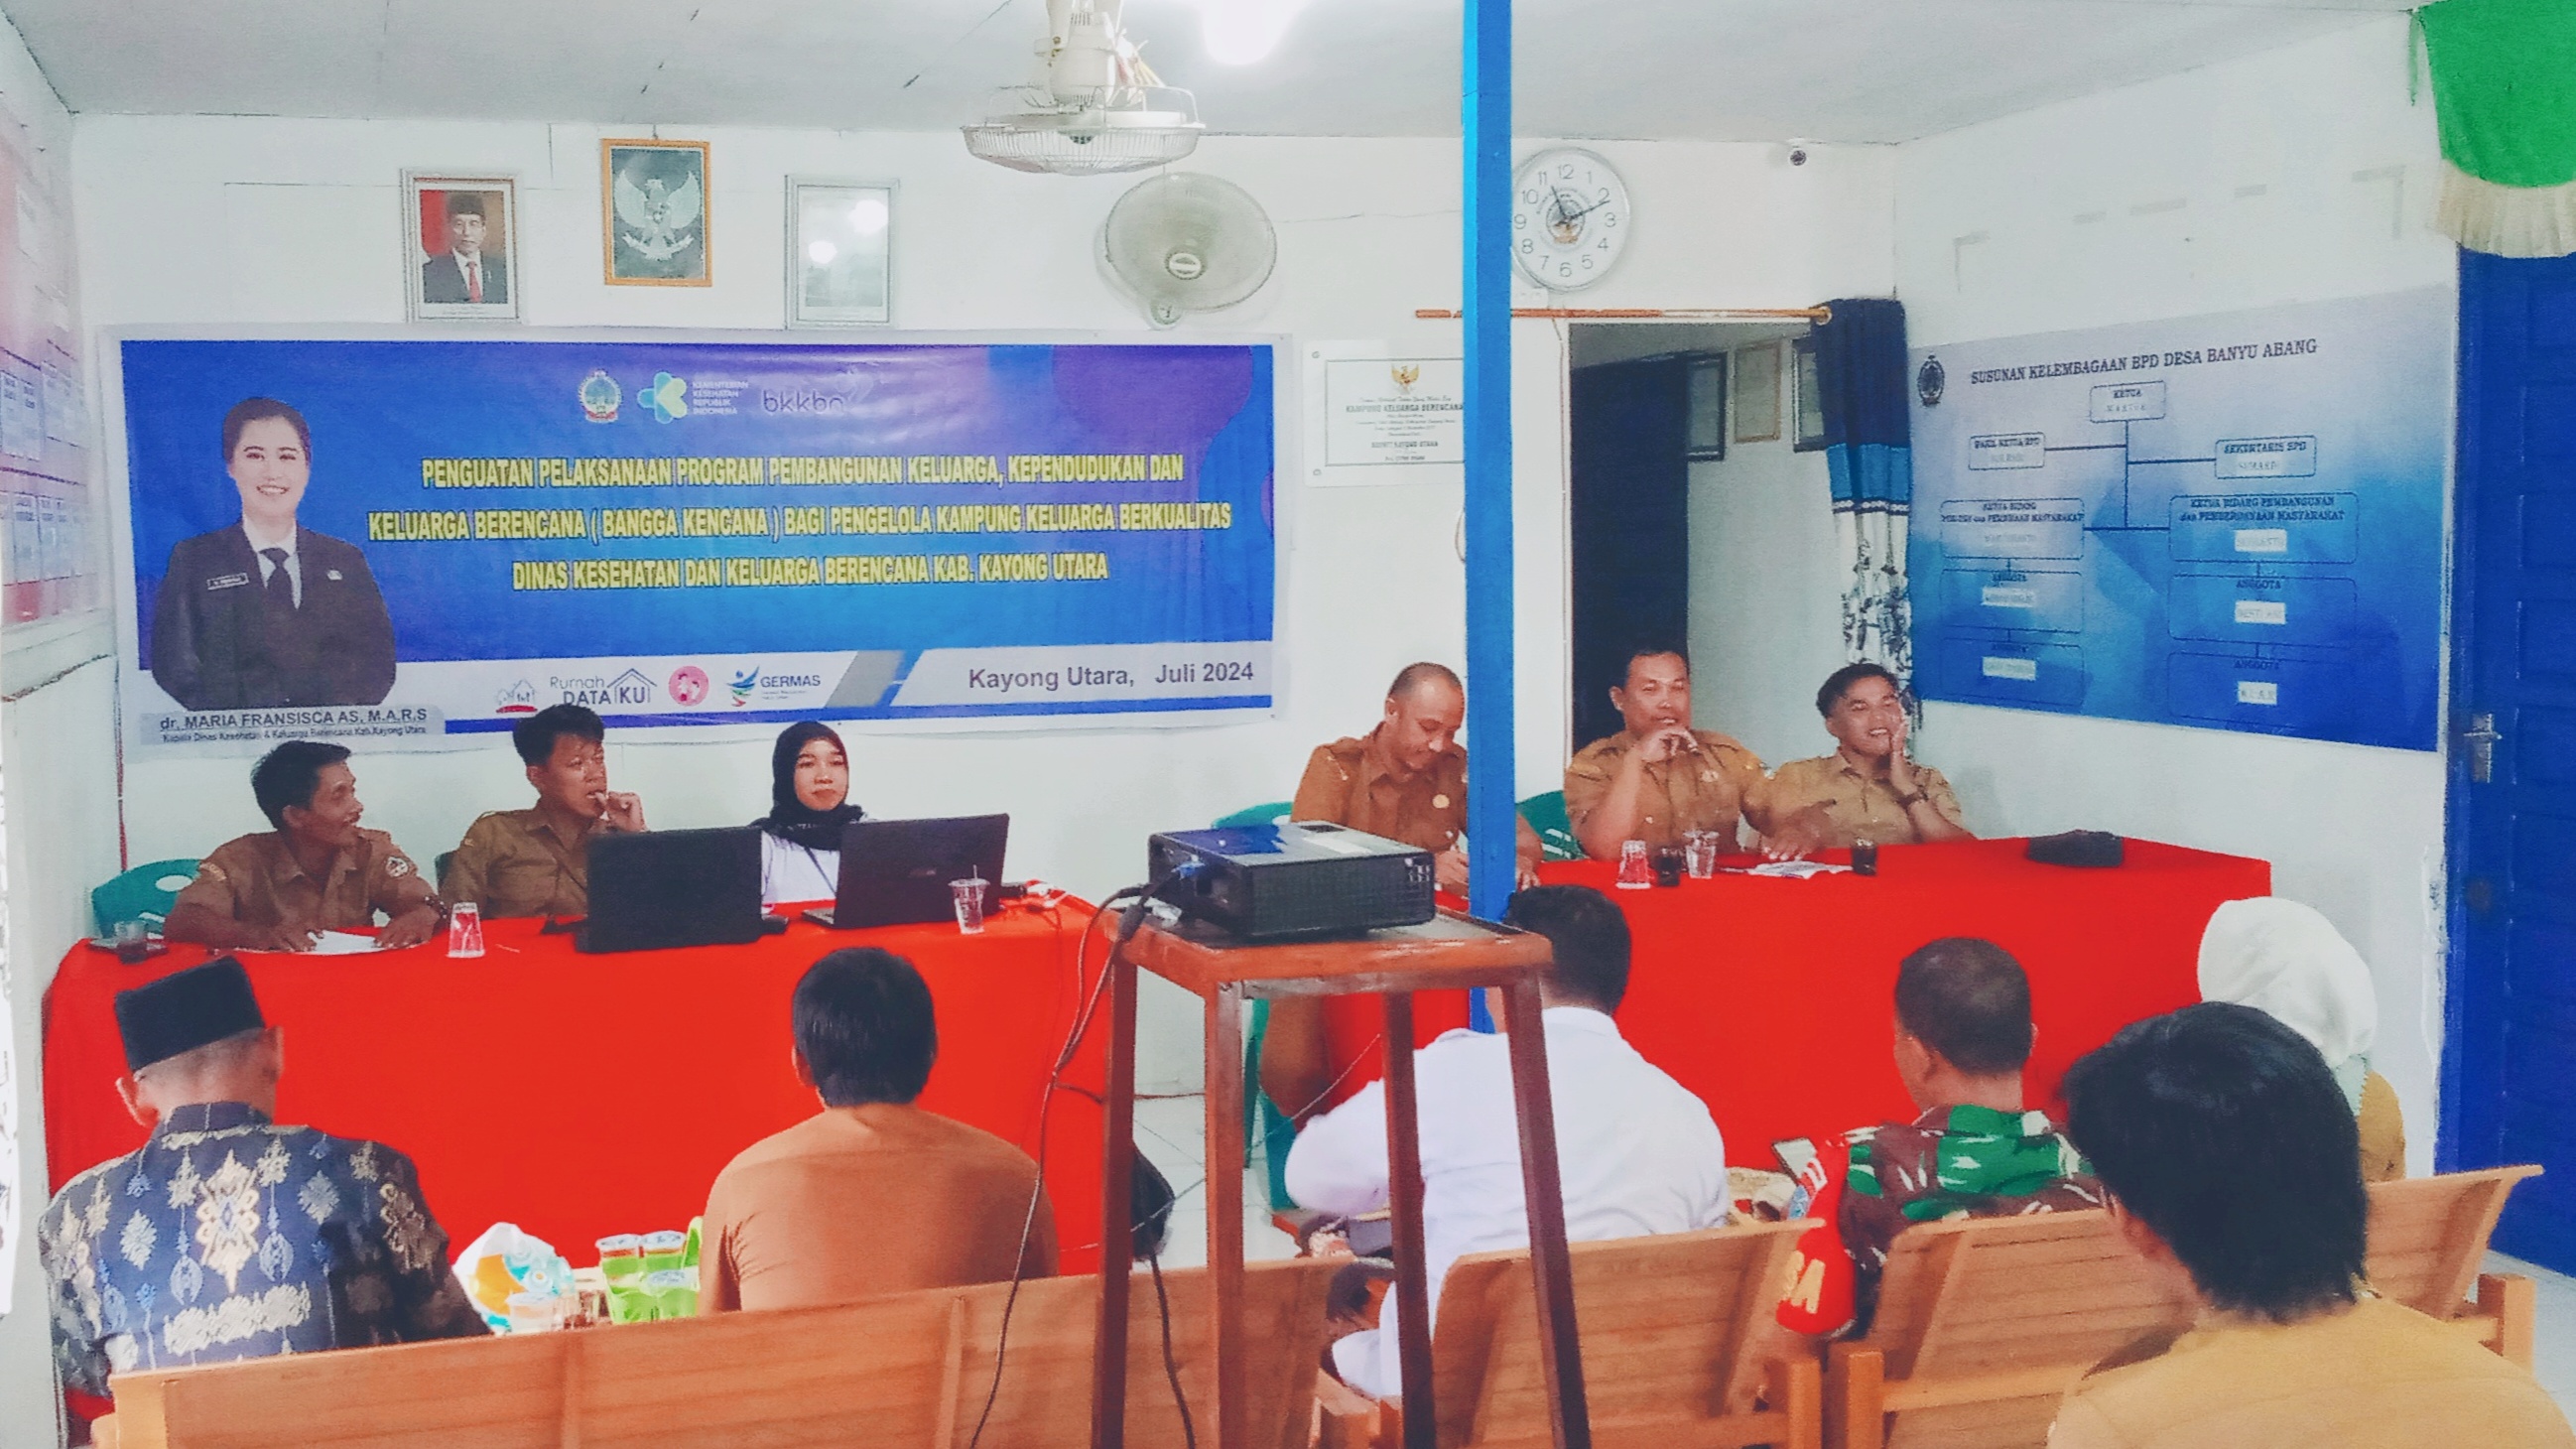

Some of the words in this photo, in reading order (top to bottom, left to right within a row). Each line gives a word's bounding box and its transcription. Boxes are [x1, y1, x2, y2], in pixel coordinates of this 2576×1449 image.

[1539, 171, 1548, 186] 11
[1558, 164, 1574, 180] 12
[1522, 189, 1538, 204] 10
[1598, 188, 1610, 204] 2
[1513, 213, 1527, 229] 9
[1605, 212, 1616, 228] 3
[1521, 238, 1534, 254] 8
[1597, 238, 1609, 251] 4
[1539, 255, 1550, 270] 7
[1559, 262, 1572, 278] 6
[1582, 254, 1594, 270] 5
[1971, 365, 2026, 385] SUSUNAN
[2028, 357, 2127, 379] KELEMBAGAAN
[2131, 354, 2160, 370] BPD
[2164, 349, 2202, 367] DESA
[2207, 343, 2258, 363] BANYU
[2262, 337, 2318, 358] ABANG
[763, 389, 843, 413] bkkbn
[422, 458, 533, 487] PENGUATAN
[539, 458, 672, 487] PELAKSANAAN
[677, 457, 764, 486] PROGRAM
[769, 457, 902, 486] PEMBANGUNAN
[907, 456, 1003, 487] KELUARGA,
[1007, 455, 1147, 483] KEPENDUDUKAN
[1150, 455, 1184, 481] DAN
[368, 511, 470, 541] KELUARGA
[475, 510, 585, 541] BERENCANA
[602, 508, 678, 539] BANGGA
[682, 507, 770, 537] KENCANA
[784, 506, 826, 536] BAGI
[831, 505, 933, 535] PENGELOLA
[936, 504, 1022, 533] KAMPUNG
[1025, 503, 1115, 532] KELUARGA
[1119, 502, 1231, 531] BERKUALITAS
[513, 561, 570, 591] DINAS
[573, 559, 682, 590] KESEHATAN
[685, 558, 721, 588] DAN
[725, 557, 821, 587] KELUARGA
[824, 555, 930, 585] BERENCANA
[933, 554, 975, 584] KAB.
[978, 553, 1050, 582] KAYONG
[1052, 552, 1109, 581] UTARA
[550, 676, 604, 689] Rumah
[760, 675, 822, 688] GERMAS
[968, 667, 1059, 693] Kayong
[1067, 666, 1134, 688] Utara,
[1155, 663, 1196, 685] Juli
[1203, 662, 1254, 683] 2024
[564, 690, 611, 705] DATA
[619, 687, 646, 704] KU
[185, 715, 237, 728] MARIA
[241, 712, 333, 726] FRANSISCA
